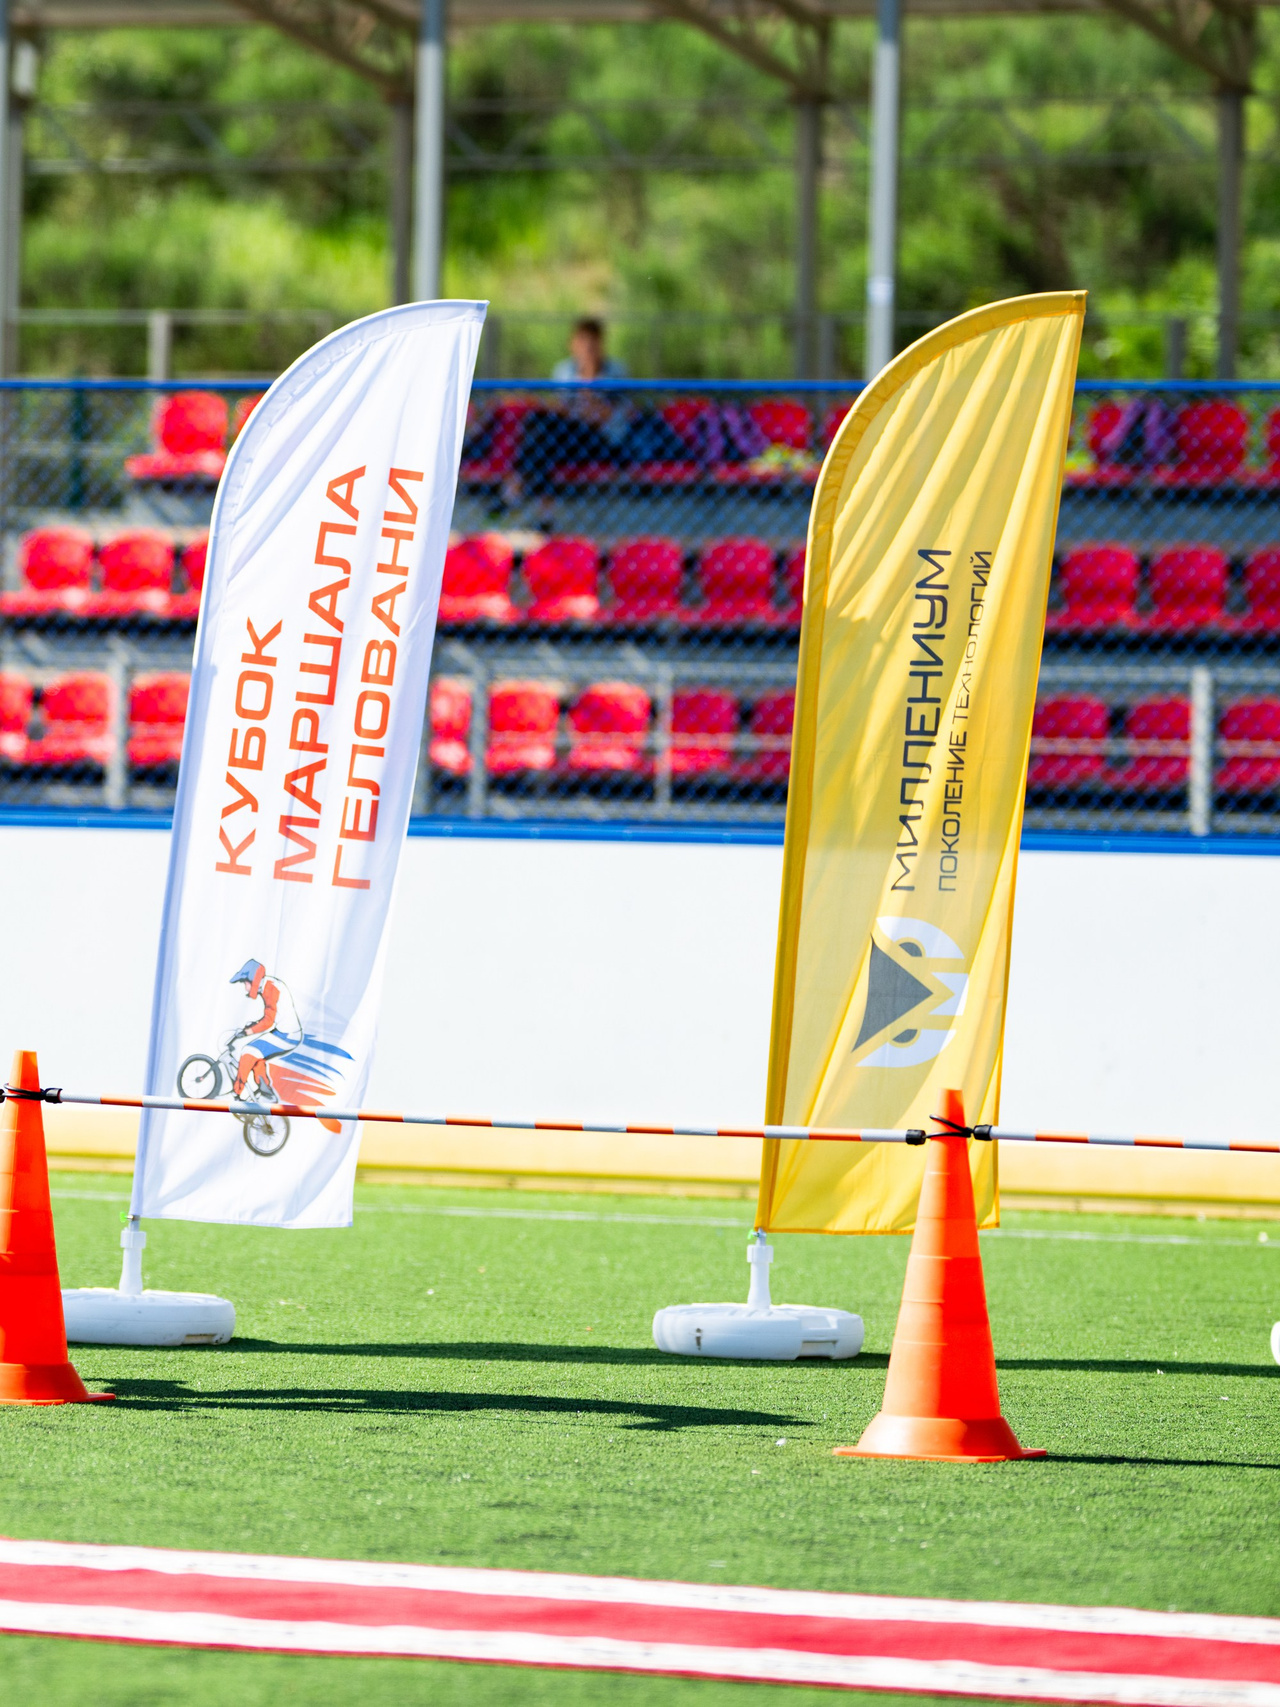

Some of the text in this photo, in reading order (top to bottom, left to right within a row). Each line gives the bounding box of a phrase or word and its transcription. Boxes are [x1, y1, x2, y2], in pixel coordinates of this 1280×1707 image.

[215, 616, 283, 876] КУБОК
[273, 465, 367, 883] МАРШАЛА
[331, 467, 424, 890] ГЕЛОВАНИ
[890, 548, 952, 892] МИЛЛЕНИУМ
[938, 551, 993, 892] ПОКОЛЕНИЕ ТЕХНОЛОГИЙ
